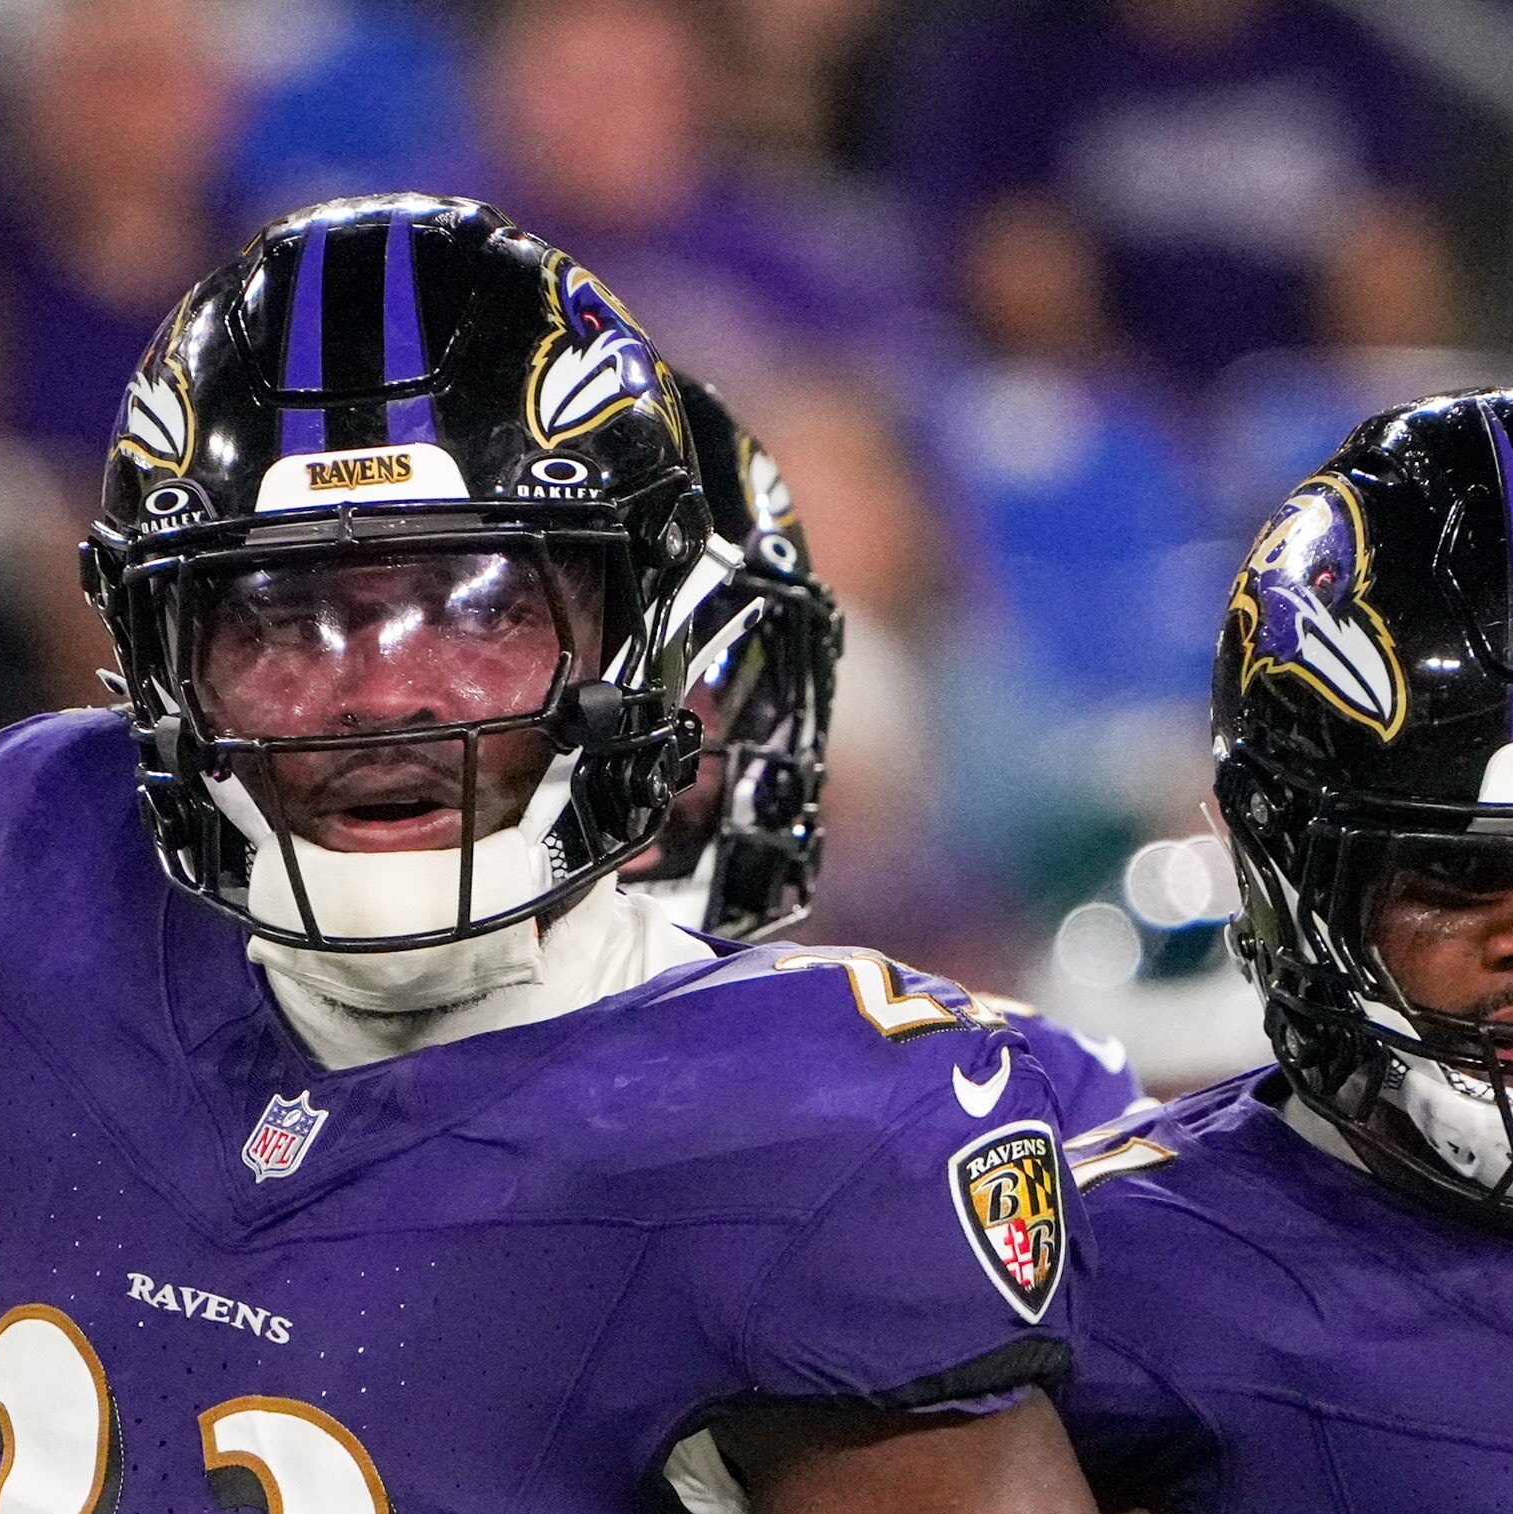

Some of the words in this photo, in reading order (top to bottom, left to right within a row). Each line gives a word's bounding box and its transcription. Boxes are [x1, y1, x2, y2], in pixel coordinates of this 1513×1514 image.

[306, 453, 412, 490] RAVENS
[517, 485, 599, 499] OAKLEY
[251, 1127, 297, 1165] NFL
[966, 1137, 1047, 1180] RAVENS
[127, 1272, 294, 1345] RAVENS
